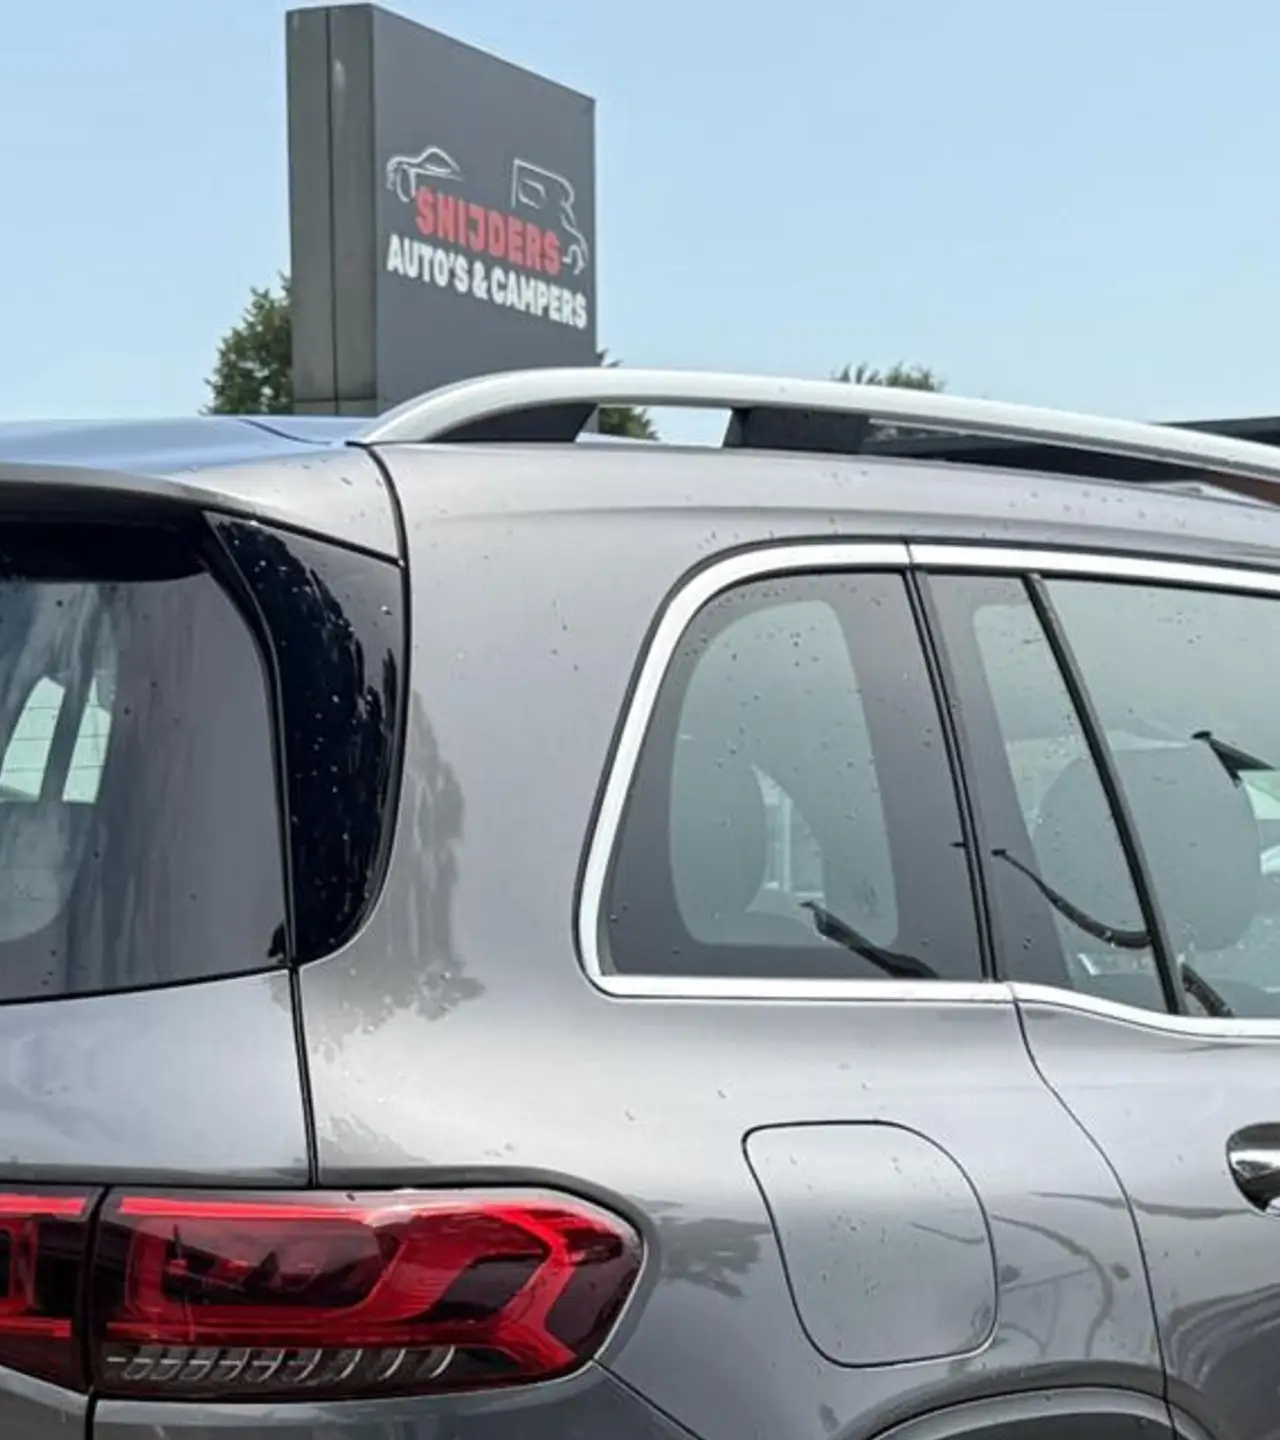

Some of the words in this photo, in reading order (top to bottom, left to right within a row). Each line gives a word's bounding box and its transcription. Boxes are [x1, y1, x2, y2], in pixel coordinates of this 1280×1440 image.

[416, 185, 562, 275] SNIJDERS
[387, 234, 470, 293] AUTO'S
[472, 260, 489, 300] &
[491, 265, 587, 330] CAMPERS
